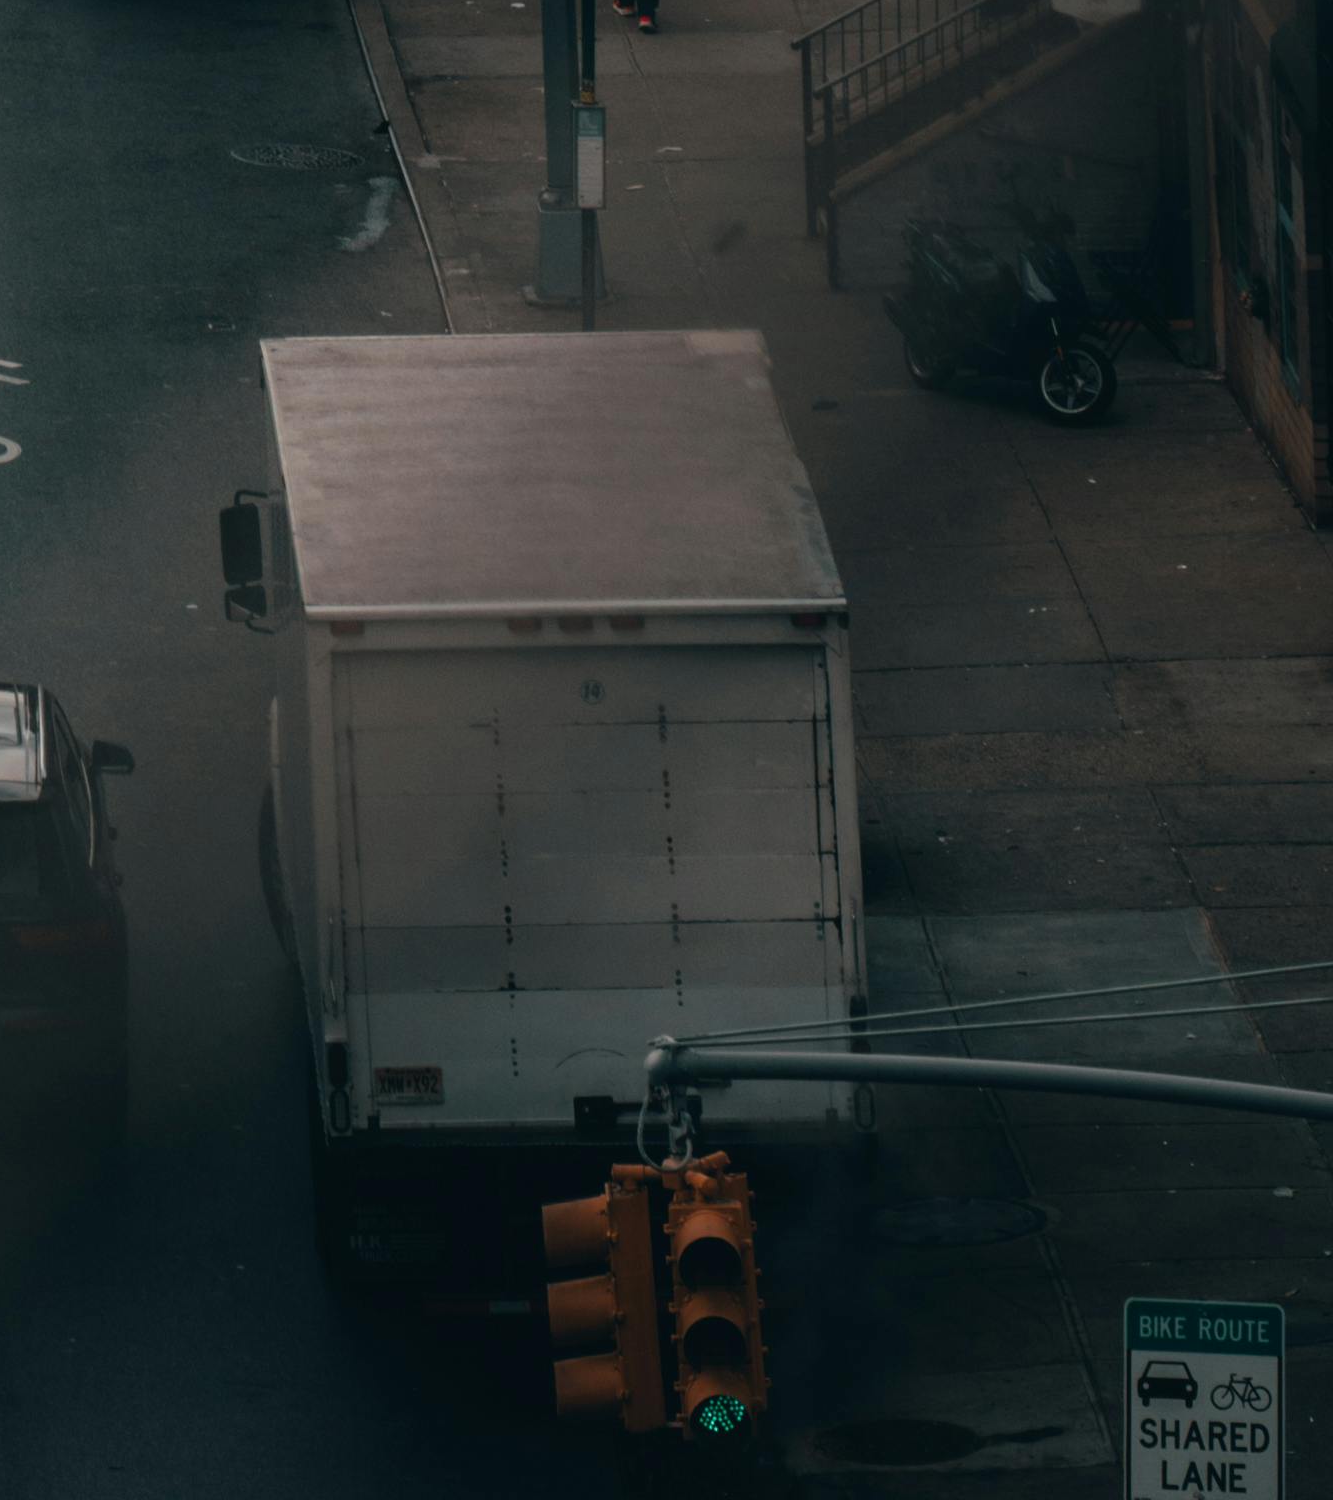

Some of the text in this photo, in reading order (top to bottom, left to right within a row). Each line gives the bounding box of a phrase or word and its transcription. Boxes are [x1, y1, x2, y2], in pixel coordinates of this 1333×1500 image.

[1138, 1314, 1271, 1343] BIKE ROUTE
[1138, 1416, 1271, 1454] SHARED
[1161, 1459, 1248, 1494] LANE
